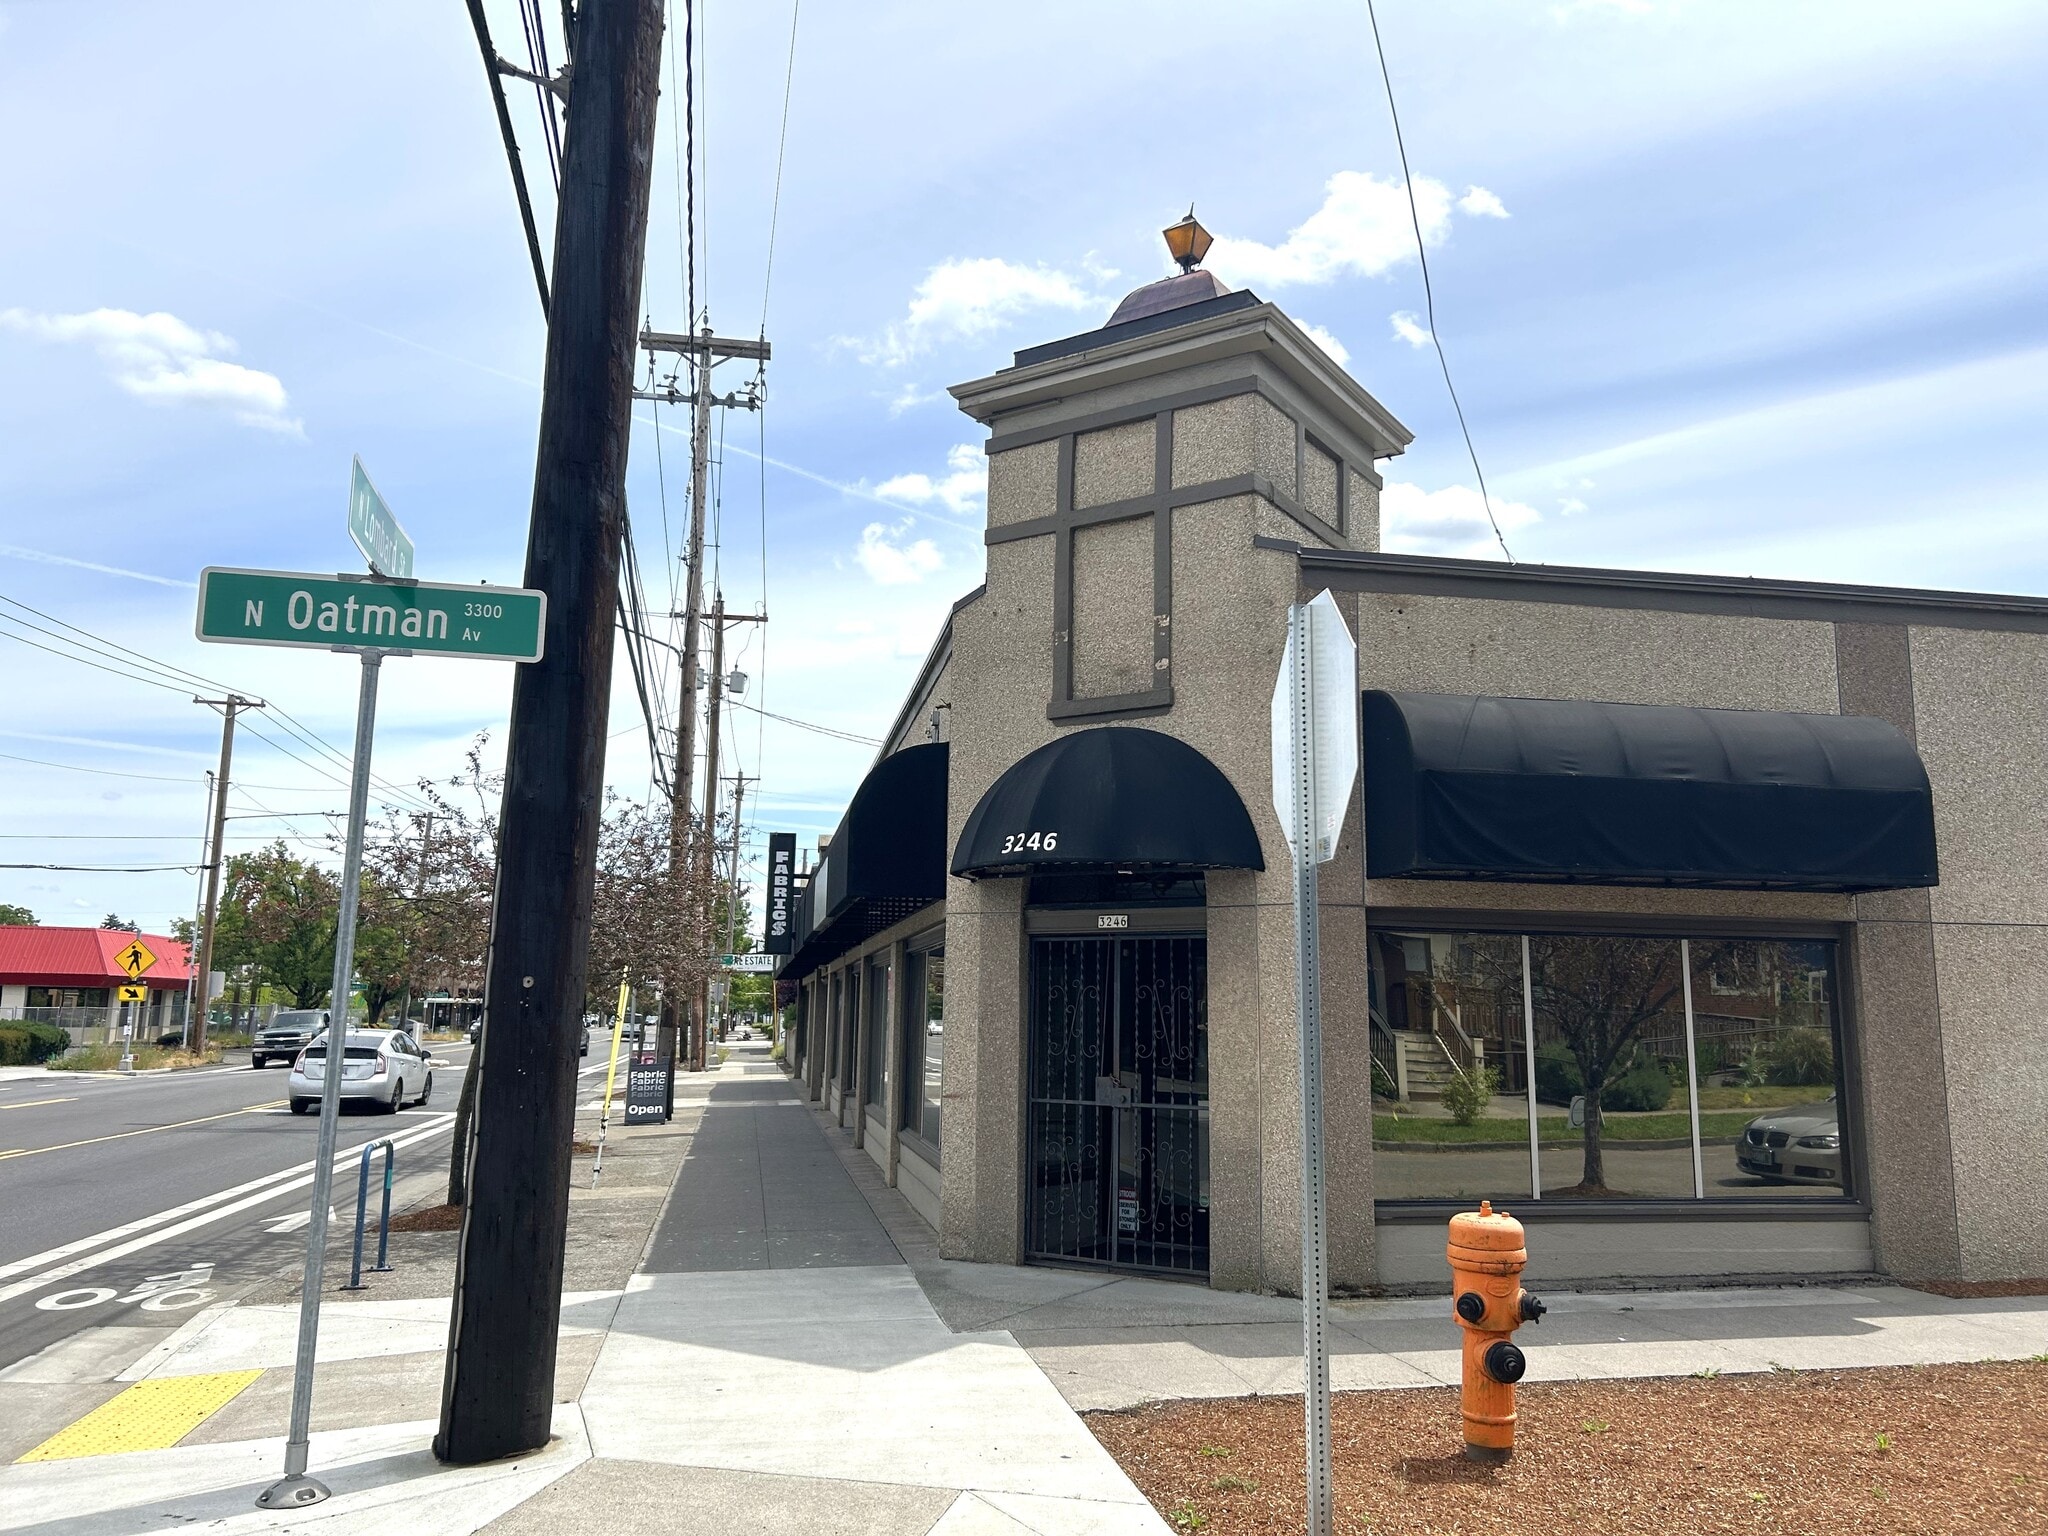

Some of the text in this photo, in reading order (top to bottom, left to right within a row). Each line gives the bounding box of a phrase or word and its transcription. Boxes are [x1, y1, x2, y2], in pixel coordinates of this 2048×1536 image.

[359, 490, 365, 521] N
[364, 495, 398, 575] Lombard
[244, 590, 448, 640] N Oatman
[464, 603, 502, 619] 3300
[462, 627, 481, 642] Av
[1001, 832, 1058, 854] 3246
[771, 851, 789, 936] FABRICS
[1099, 916, 1127, 927] 3246
[744, 956, 772, 966] ESTATE
[630, 1070, 667, 1079] Fabric
[628, 1104, 663, 1115] Open
